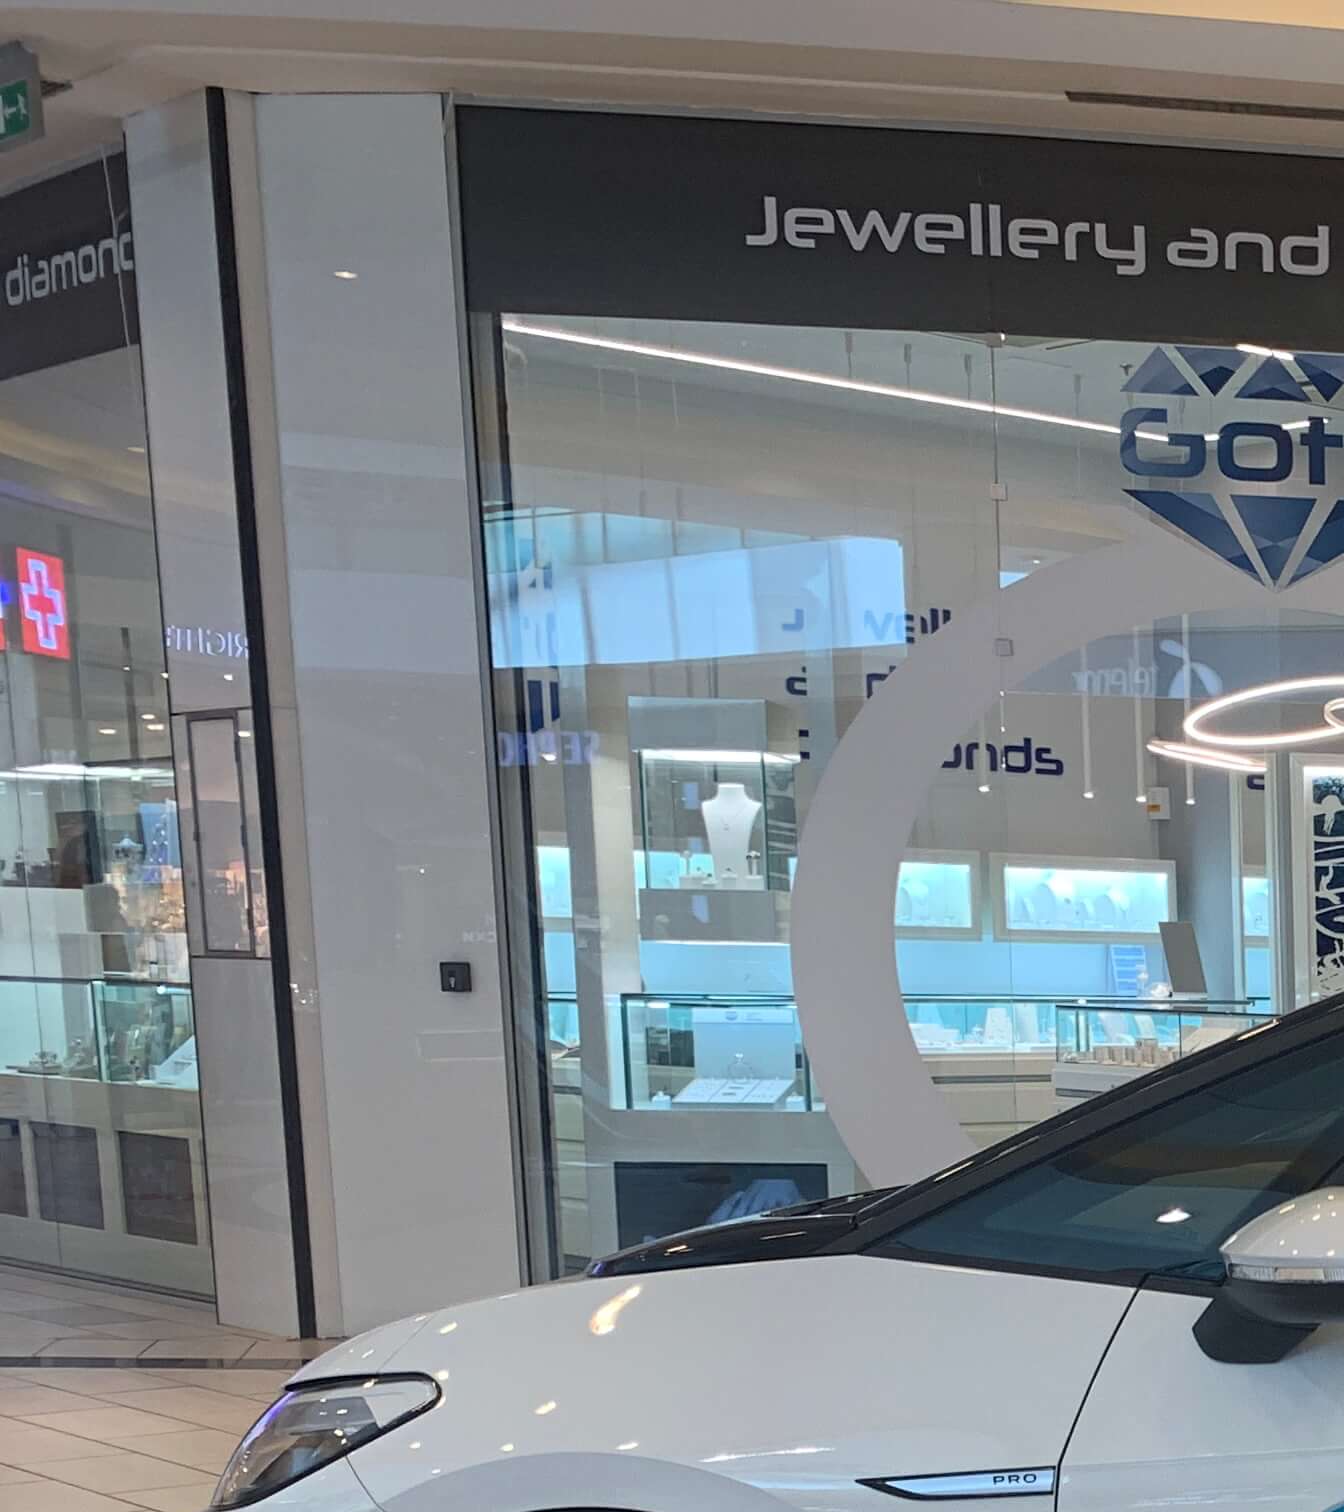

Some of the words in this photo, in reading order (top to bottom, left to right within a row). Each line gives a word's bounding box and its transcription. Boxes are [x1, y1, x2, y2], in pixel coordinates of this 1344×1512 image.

[745, 195, 1146, 276] Jewellery
[1165, 224, 1330, 277] and
[992, 1473, 1038, 1486] PRO
